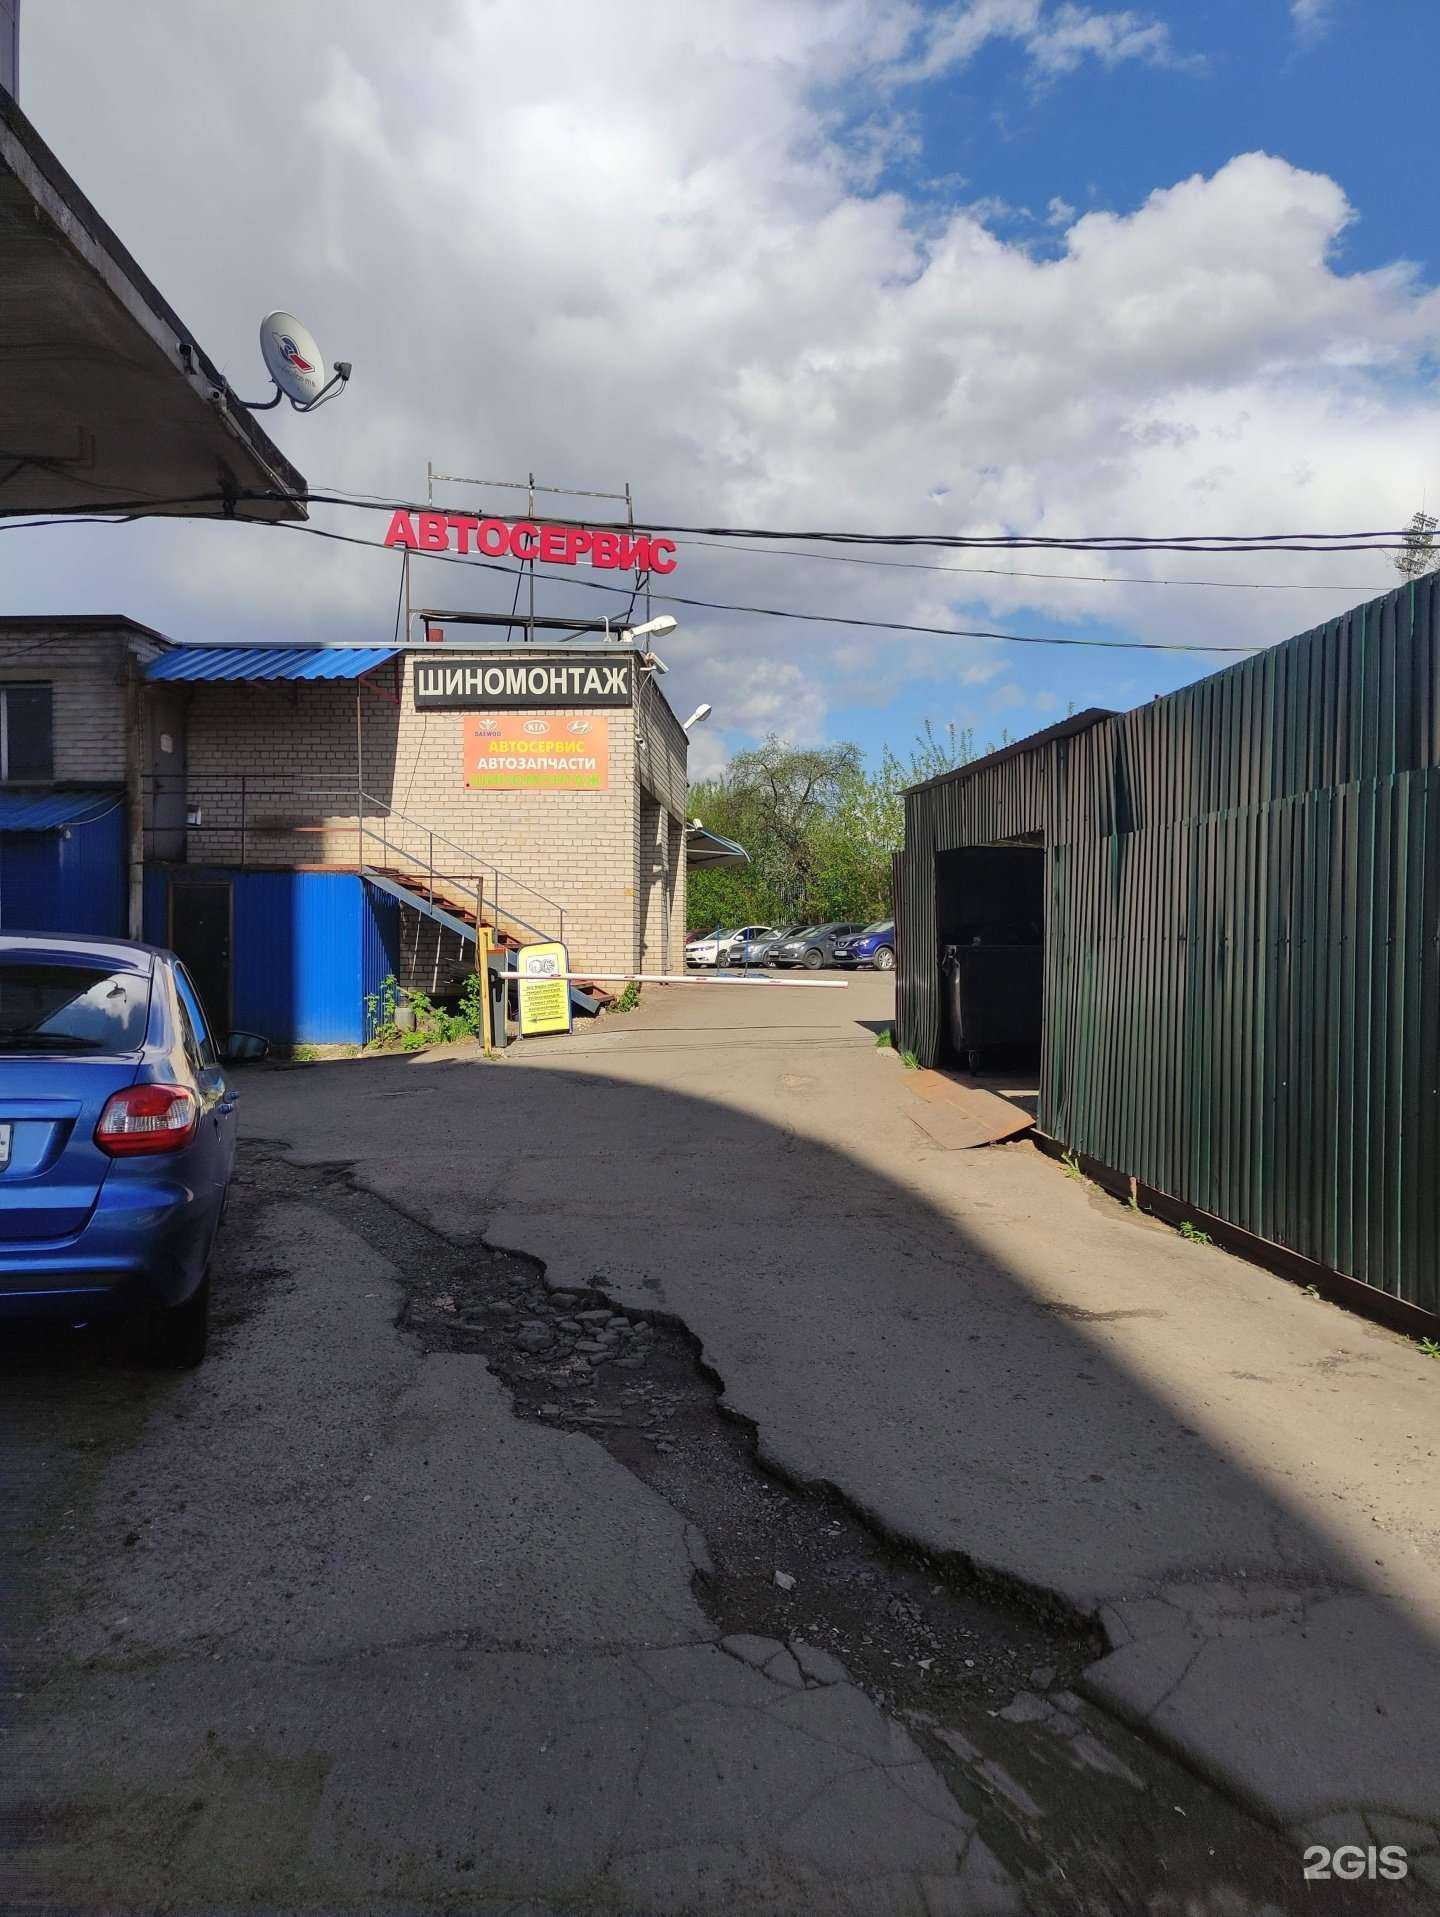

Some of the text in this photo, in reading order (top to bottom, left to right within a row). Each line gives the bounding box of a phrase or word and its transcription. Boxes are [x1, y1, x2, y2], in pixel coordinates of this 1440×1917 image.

[384, 510, 677, 574] АВТОСЕРВИС
[418, 667, 628, 696] ШИНОМОНТАЖ
[489, 741, 585, 753] АВТОСЕРВИС
[477, 757, 596, 770] АВТОЗАПЧАСТИ
